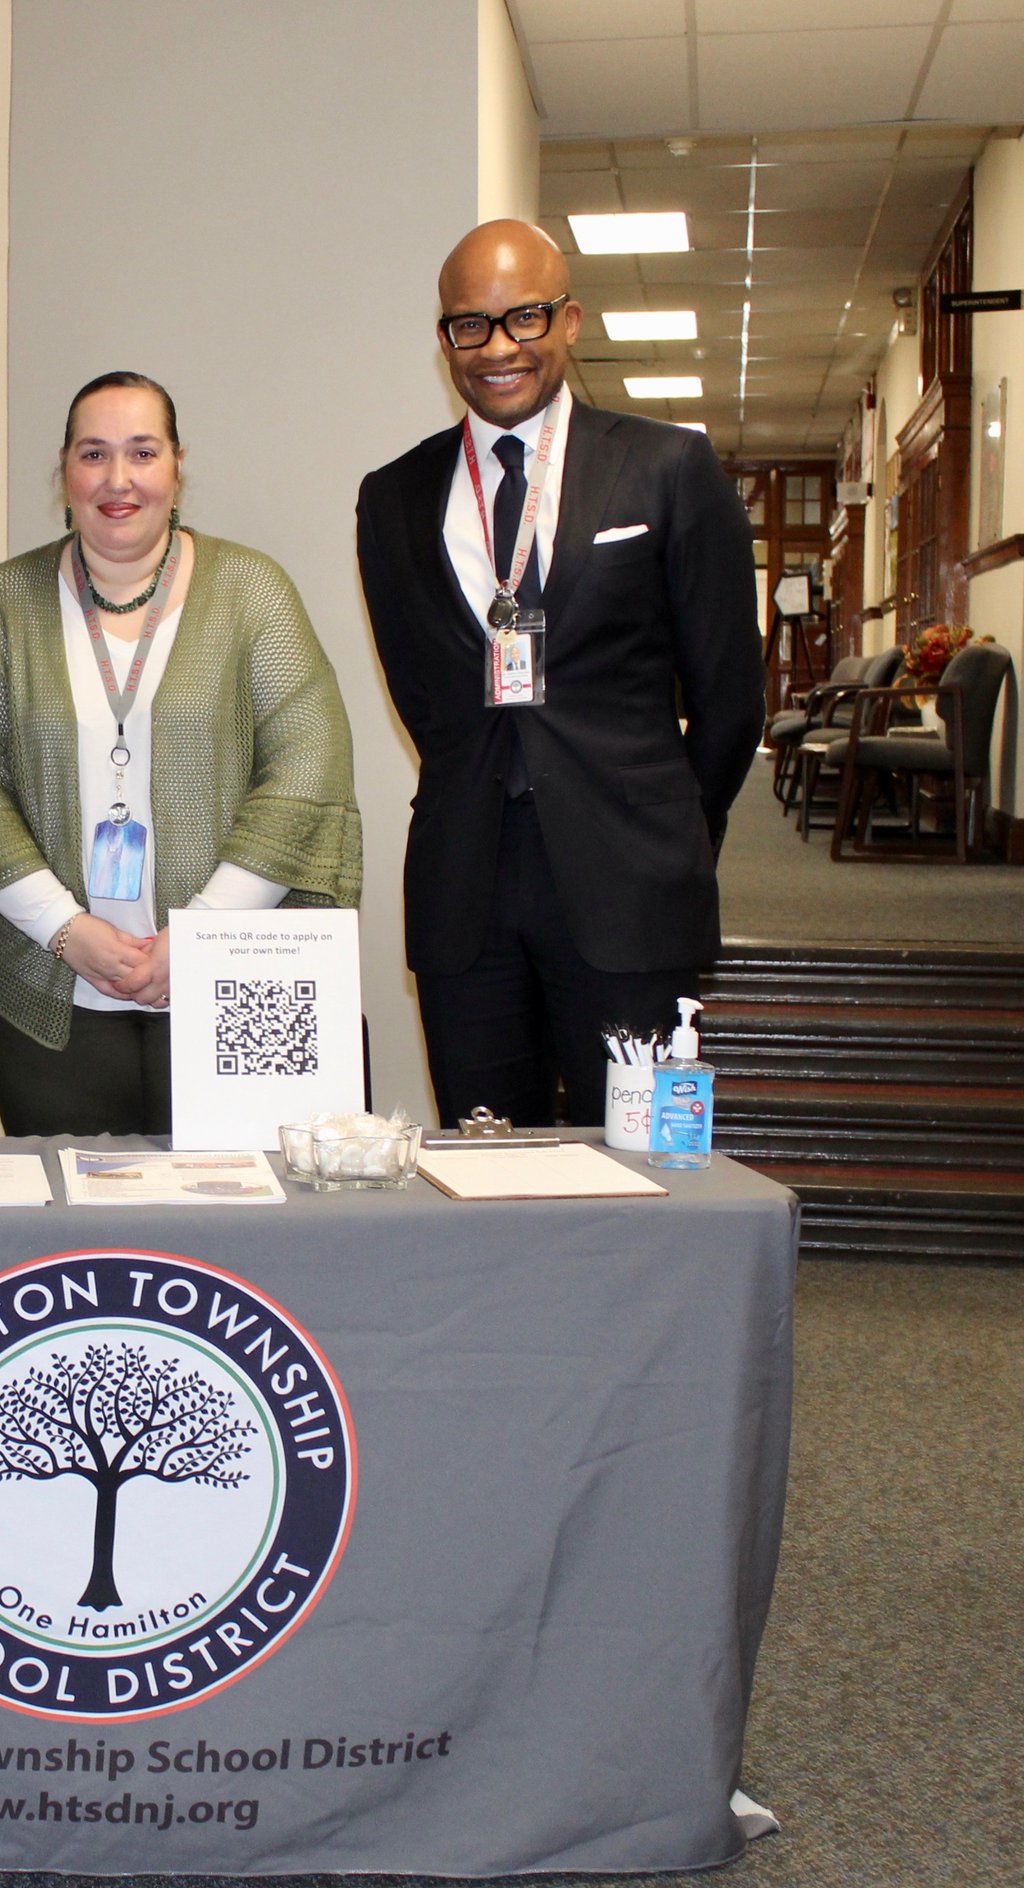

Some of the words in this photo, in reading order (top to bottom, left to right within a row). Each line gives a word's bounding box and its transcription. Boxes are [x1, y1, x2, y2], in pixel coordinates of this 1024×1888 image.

[195, 931, 218, 941] Scan
[220, 931, 237, 941] this
[239, 932, 254, 941] QR
[256, 931, 278, 941] code
[280, 933, 291, 941] to
[293, 932, 318, 943] apply
[320, 933, 333, 941] on
[228, 947, 250, 956] your
[252, 947, 273, 955] own
[275, 946, 301, 955] time!
[612, 1086, 653, 1110] penc
[130, 1271, 334, 1470] TOWNSHIP
[68, 1591, 207, 1639] Hamilton
[107, 1552, 311, 1704] DISTRICT
[147, 1738, 290, 1773] School
[303, 1729, 452, 1770] District
